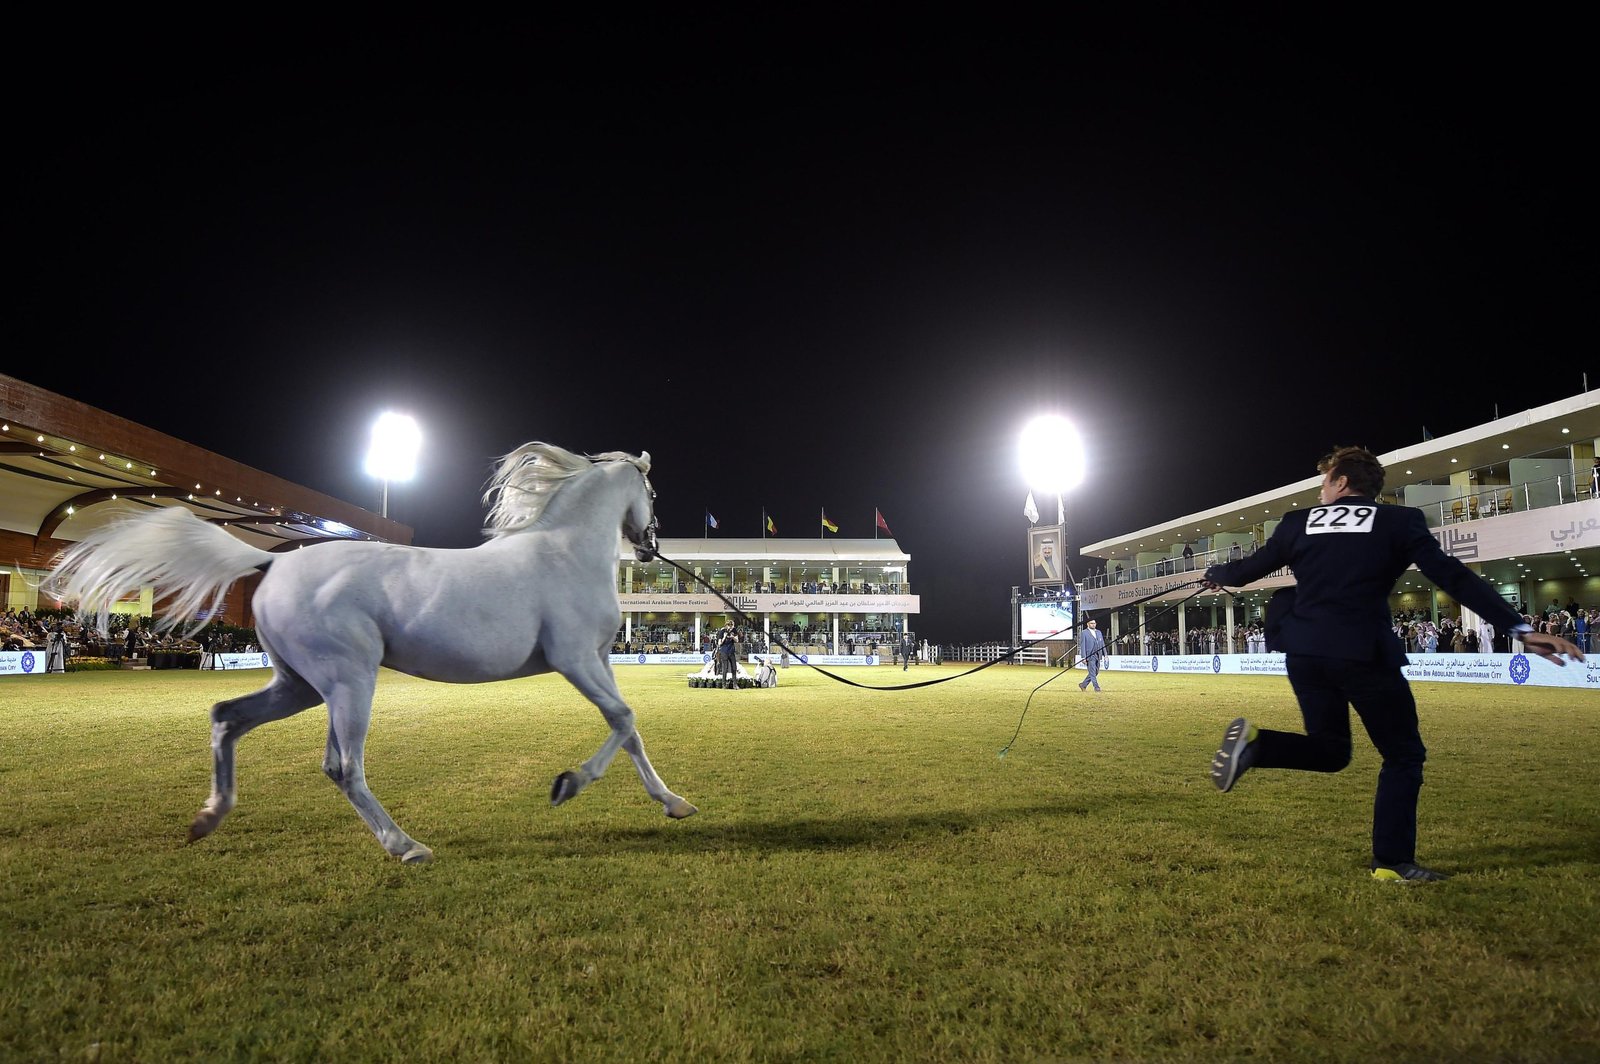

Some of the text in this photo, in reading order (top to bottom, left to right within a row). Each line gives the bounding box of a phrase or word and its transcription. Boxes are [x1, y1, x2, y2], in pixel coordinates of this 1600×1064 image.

[1309, 506, 1372, 527] 229
[1118, 589, 1134, 600] Prince
[1135, 586, 1152, 598] Sultan
[1153, 583, 1163, 594] Bin
[1473, 659, 1489, 667] سلطان
[1490, 659, 1502, 669] مدينة
